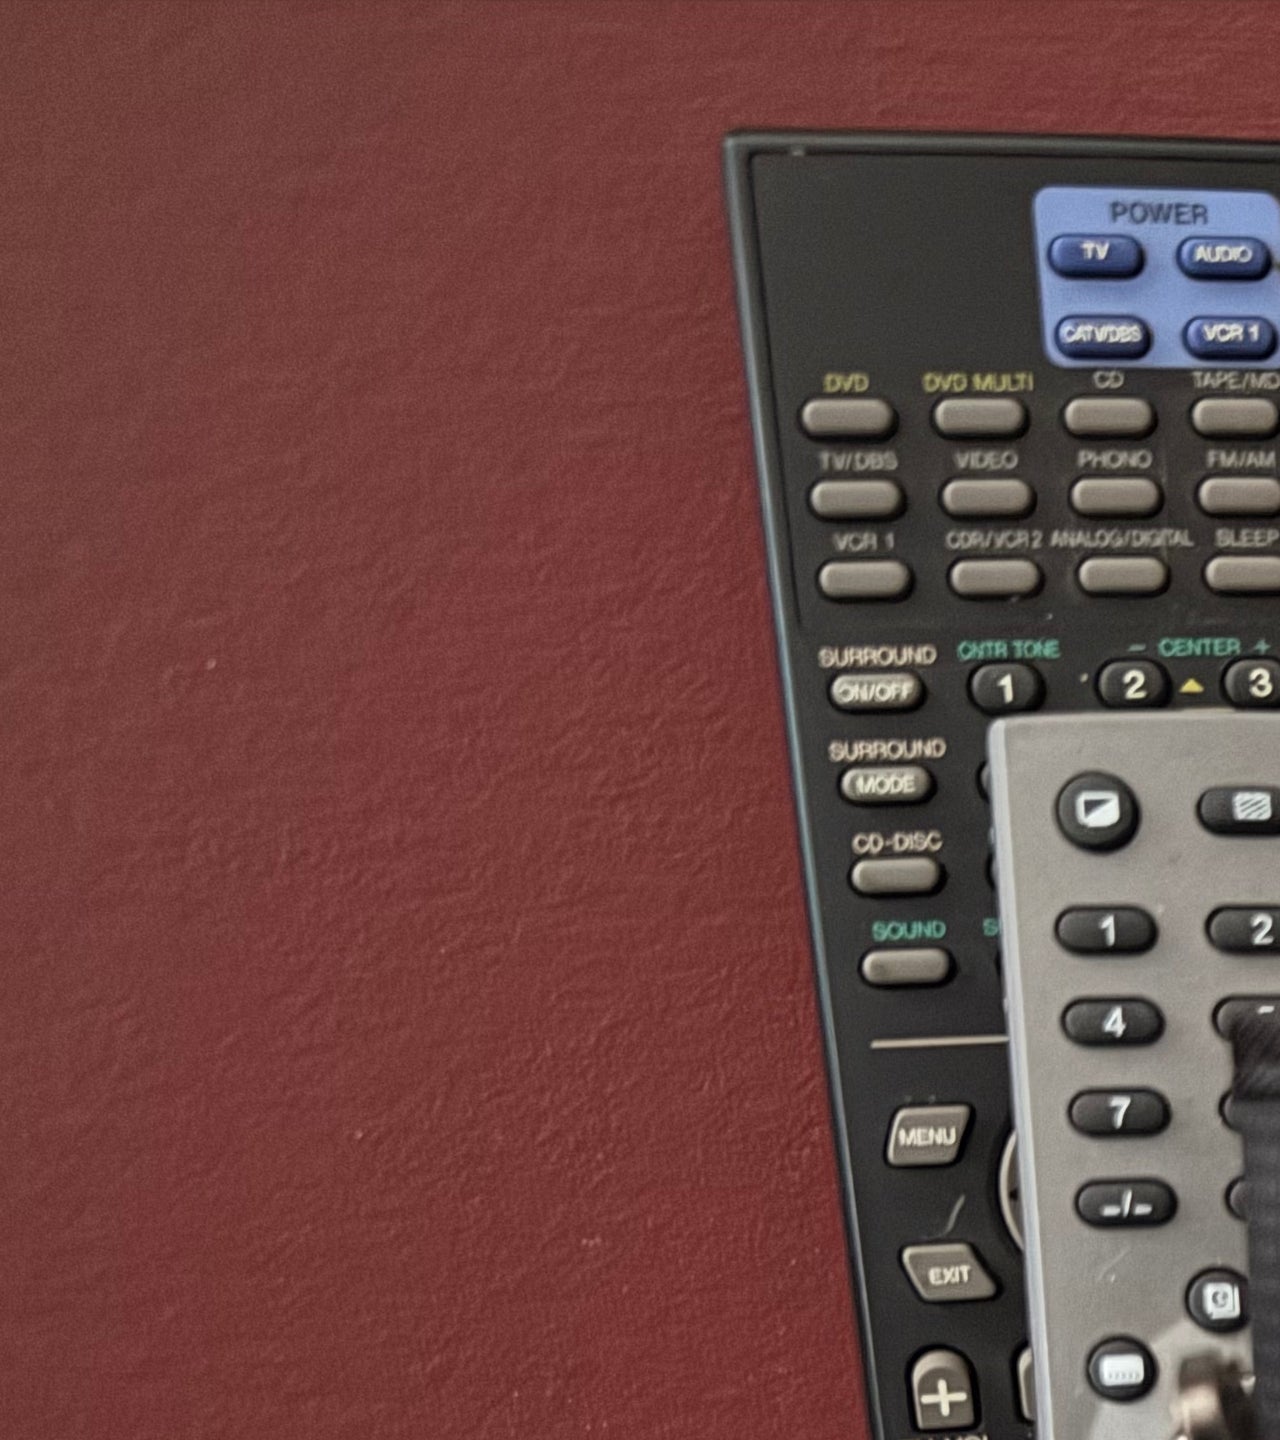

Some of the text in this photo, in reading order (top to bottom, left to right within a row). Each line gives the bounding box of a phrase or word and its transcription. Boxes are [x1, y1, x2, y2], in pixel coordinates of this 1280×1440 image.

[1111, 202, 1209, 225] POWER
[1082, 241, 1109, 260] TV
[1193, 246, 1253, 262] AUDIO
[1063, 325, 1142, 343] CATV/DBS
[1203, 324, 1260, 342] VCR 1
[823, 373, 869, 393] DVD
[923, 372, 1034, 393] DVD MULTI
[1092, 371, 1124, 389] CD
[1192, 371, 1280, 390] TAPE/MD
[819, 452, 898, 471] TV/DBS
[954, 450, 1018, 470] VIDEO
[1078, 450, 1153, 469] PHONO
[1206, 450, 1276, 468] FM/AM
[833, 532, 895, 551] VCR 1
[1051, 528, 1194, 548] ANALOG/DIGITAL
[1215, 528, 1280, 547] SLEEP
[819, 646, 937, 668] SURROUND
[1013, 638, 1061, 659] TONE
[1159, 637, 1241, 658] CENTER
[839, 678, 913, 700] ON/OFF
[997, 674, 1014, 703] 1
[1123, 670, 1148, 699] 2
[1249, 667, 1273, 698] 3
[829, 738, 947, 761] SURROUND
[856, 774, 915, 795] MODE
[851, 832, 942, 854] CD-DISC
[872, 920, 946, 942] SOUND
[1100, 914, 1115, 946] 1
[1250, 913, 1275, 946] 2
[1103, 1006, 1126, 1038] 4
[1109, 1097, 1131, 1129] 7
[898, 1127, 957, 1147] MENU
[928, 1264, 971, 1286] EXIT
